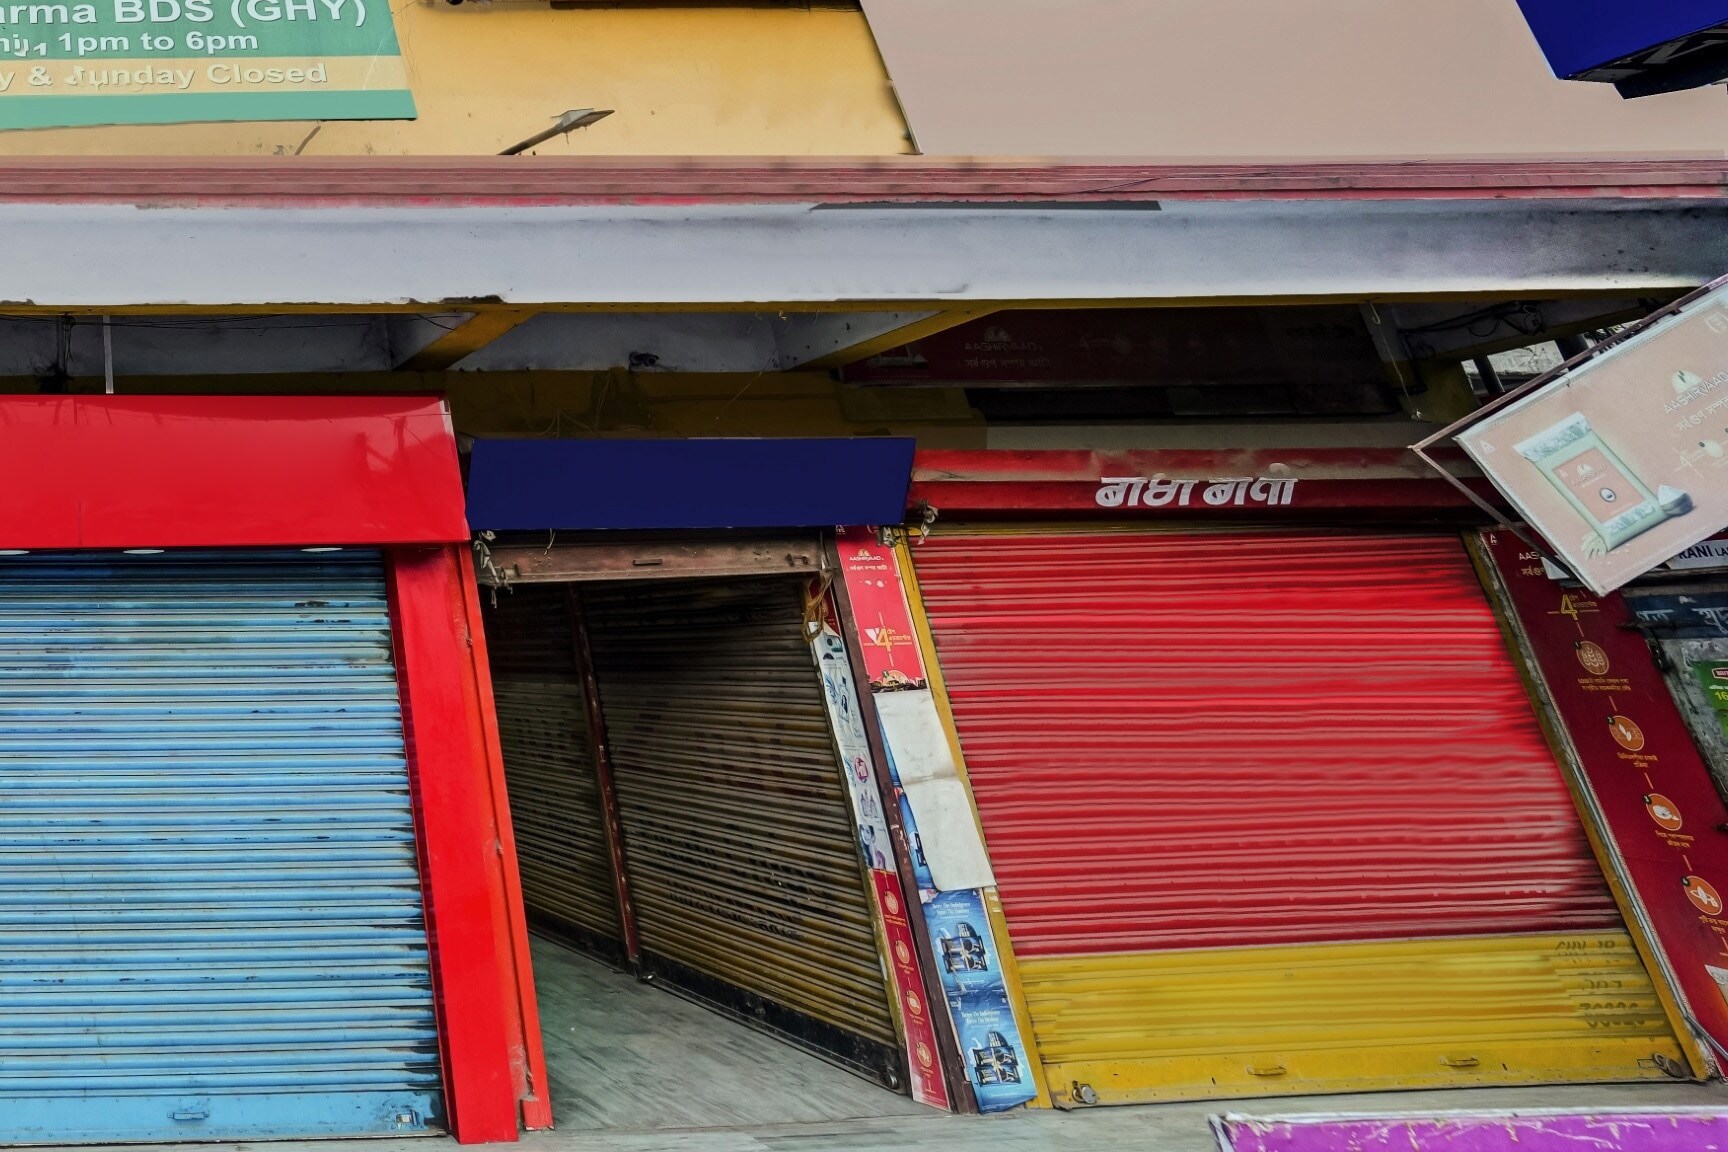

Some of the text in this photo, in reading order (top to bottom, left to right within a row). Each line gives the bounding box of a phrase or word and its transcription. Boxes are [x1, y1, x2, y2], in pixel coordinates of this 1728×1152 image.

[58, 32, 131, 57] 1pm
[139, 32, 177, 50] to
[185, 30, 259, 55] 6pm
[29, 66, 53, 87] &
[207, 63, 328, 86] Closed
